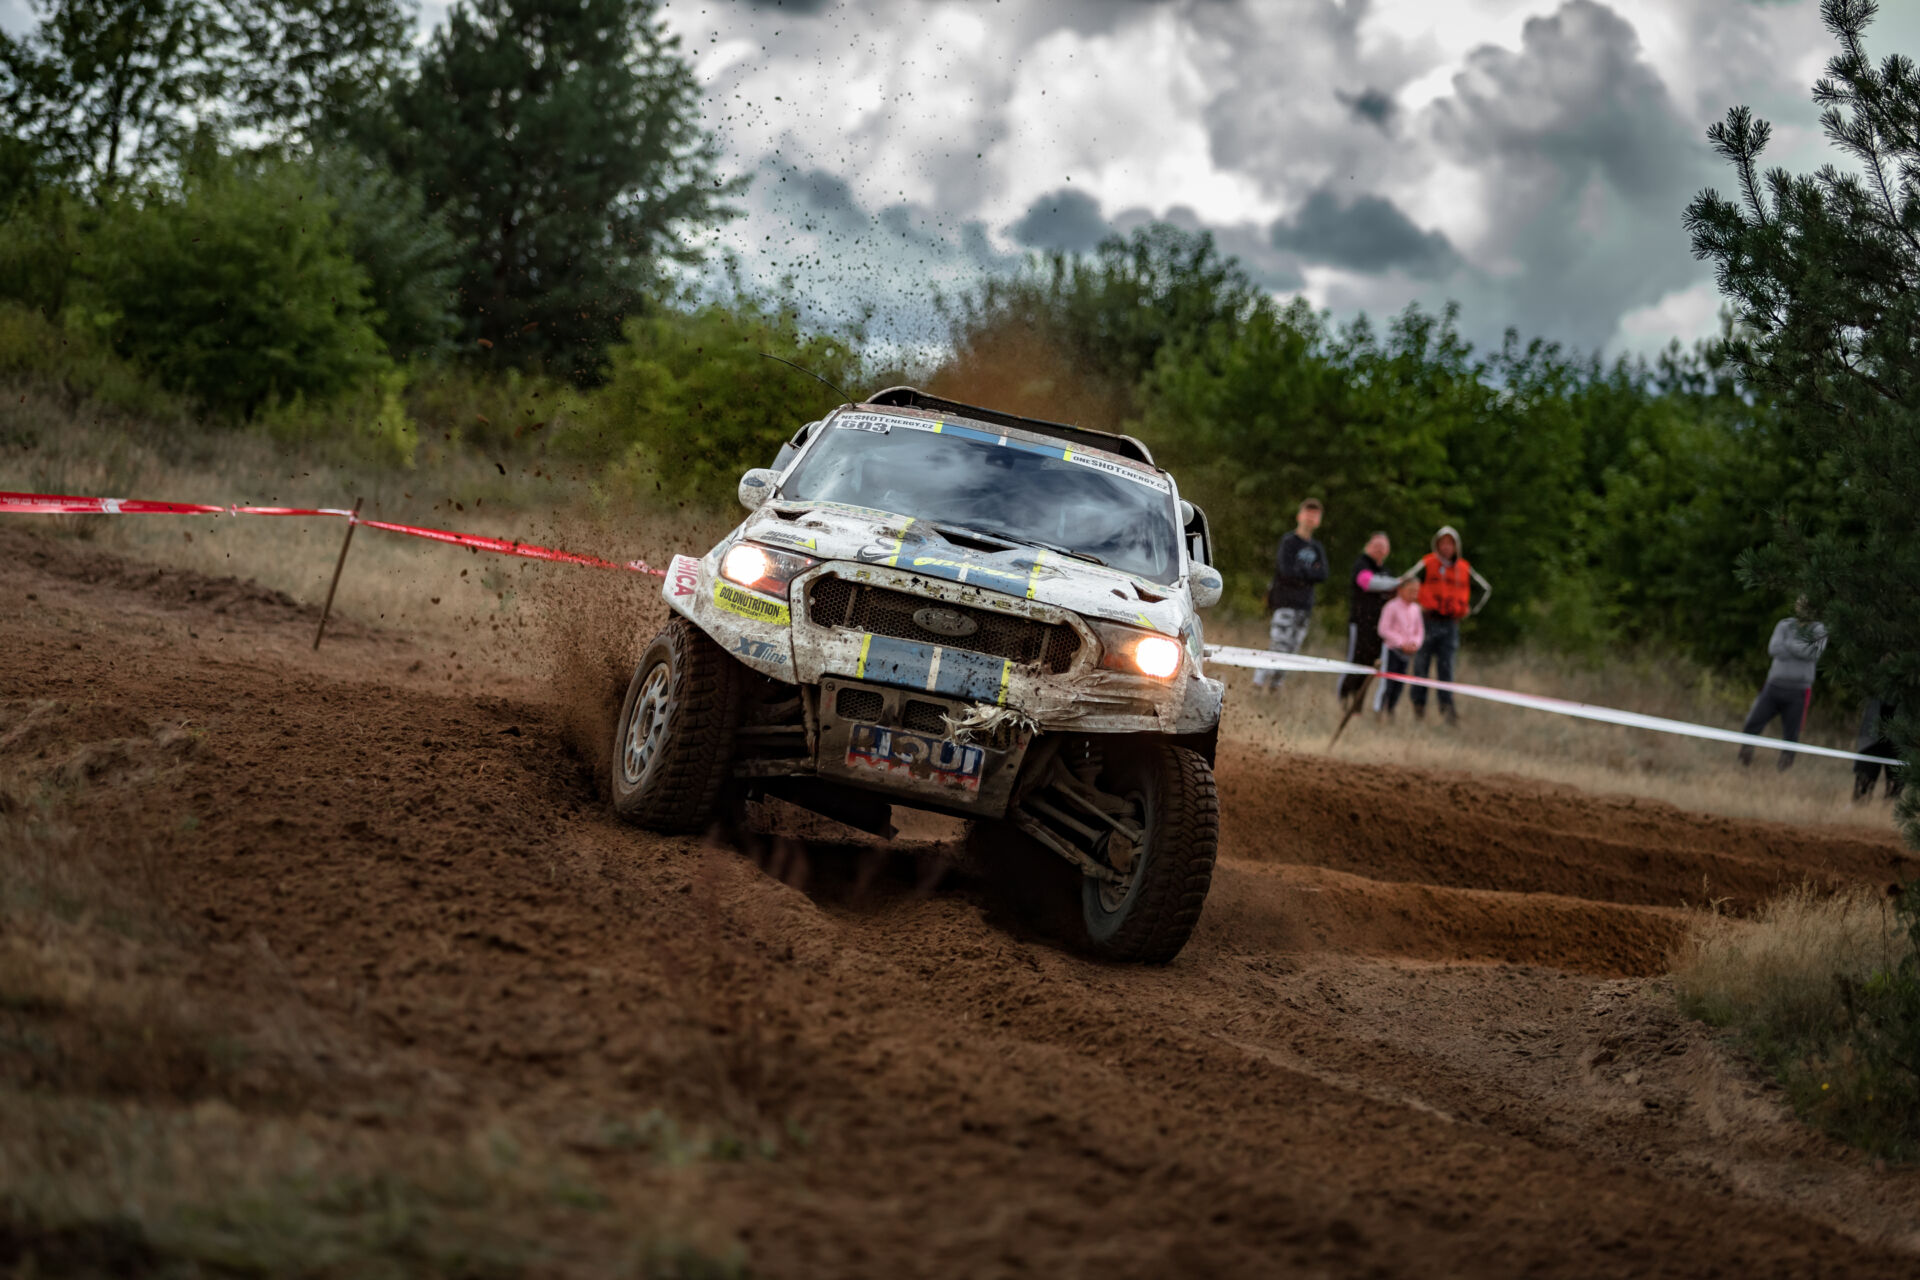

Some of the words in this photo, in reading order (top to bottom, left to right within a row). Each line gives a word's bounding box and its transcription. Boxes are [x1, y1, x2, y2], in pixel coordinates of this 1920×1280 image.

[841, 420, 889, 432] 603
[719, 586, 781, 618] GOLDNUTRITION
[732, 636, 788, 664] XTline
